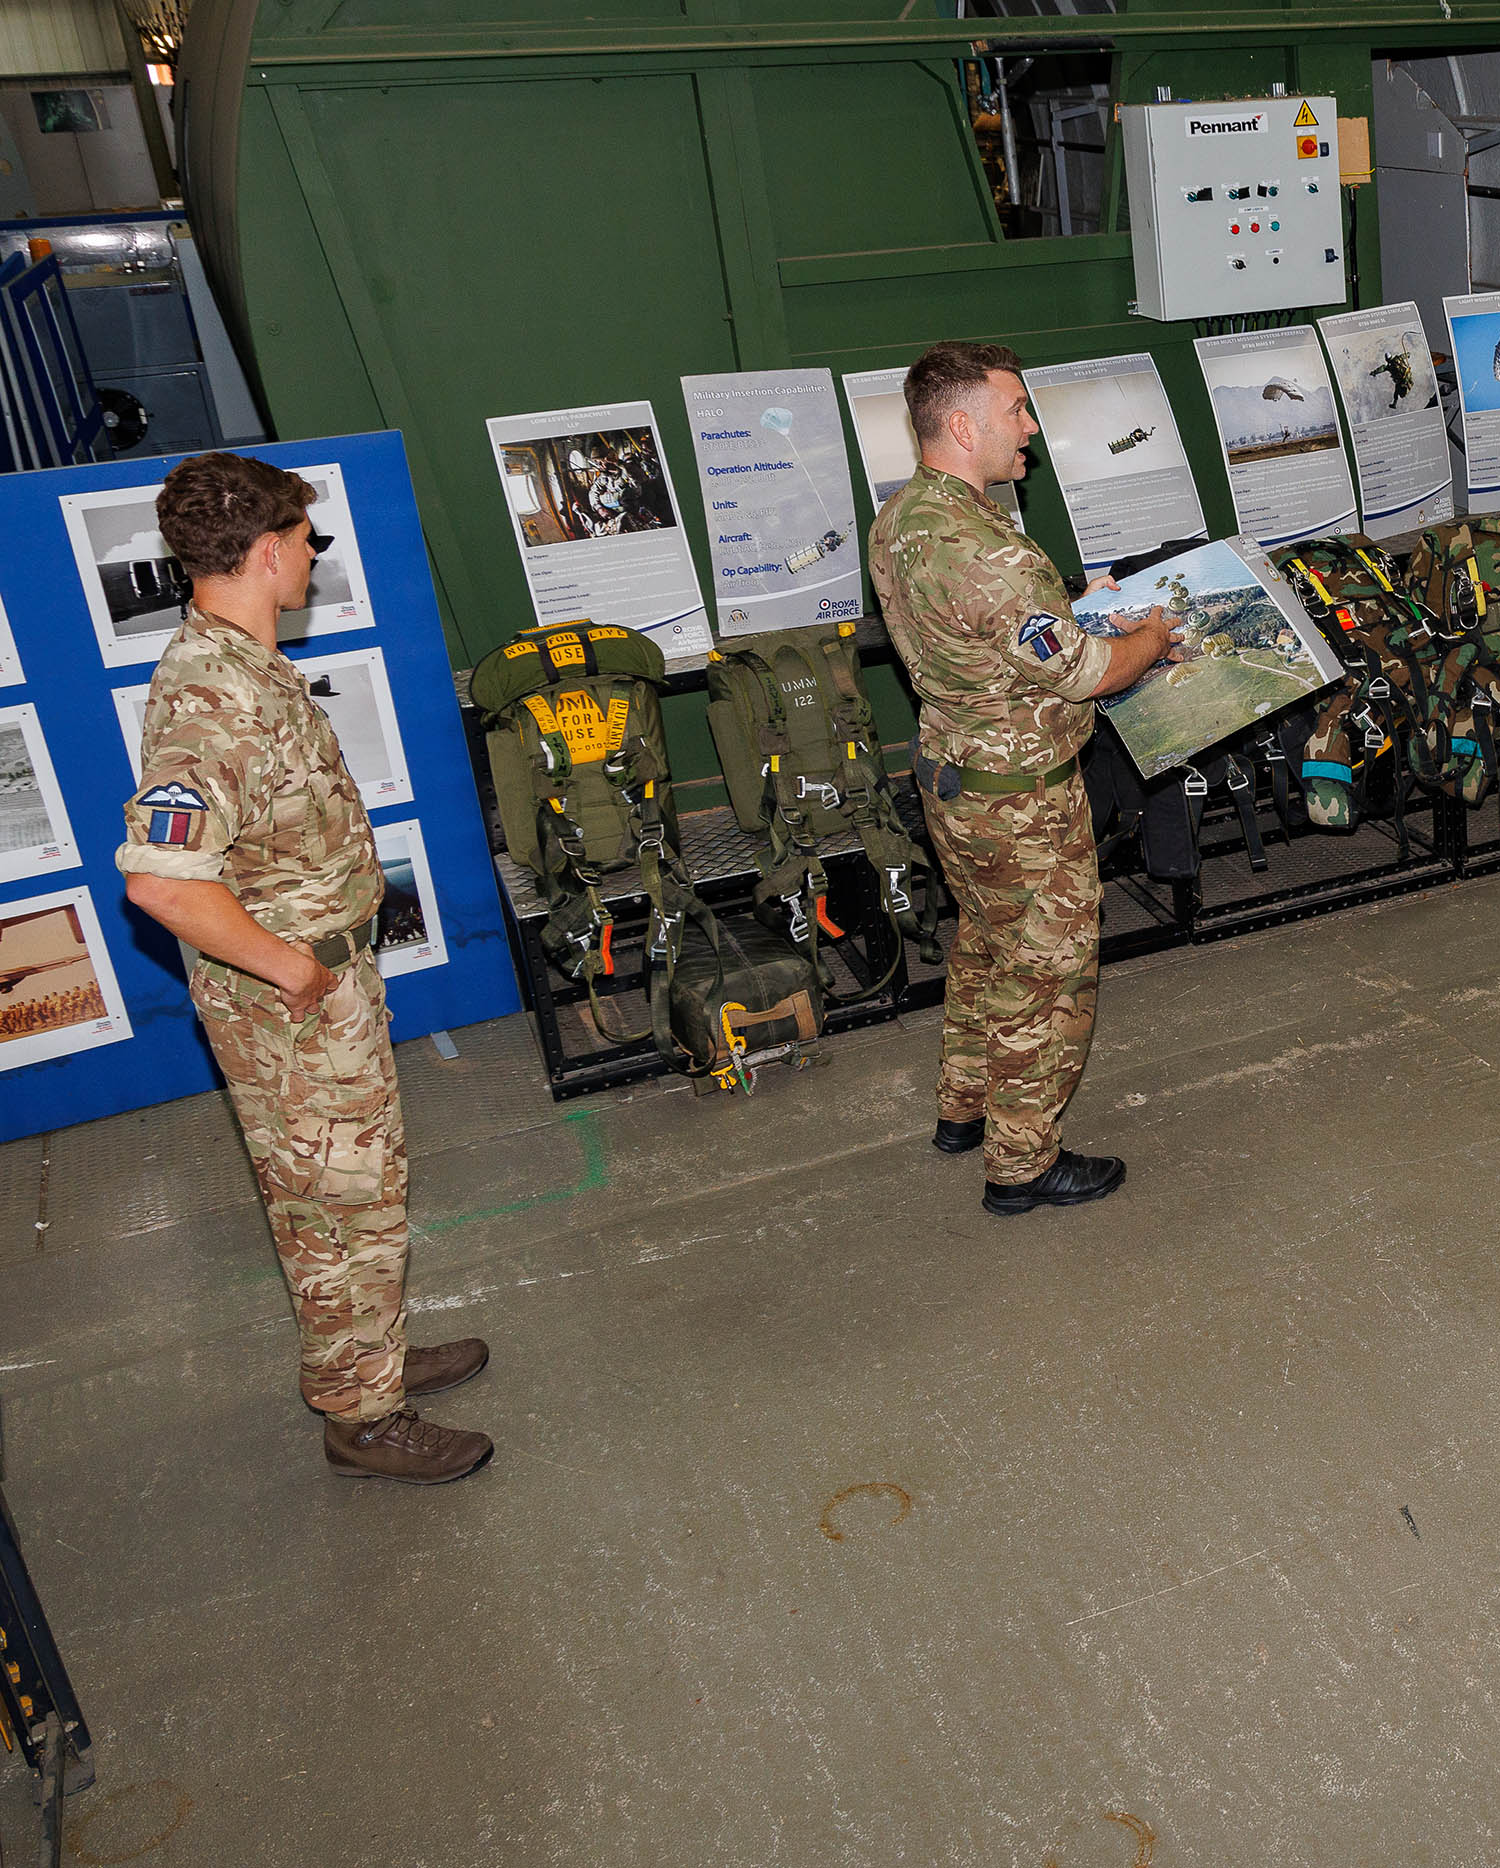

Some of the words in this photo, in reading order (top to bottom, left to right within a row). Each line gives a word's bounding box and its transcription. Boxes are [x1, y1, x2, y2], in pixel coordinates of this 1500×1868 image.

[1190, 118, 1258, 135] Pennant
[1352, 314, 1370, 322] MISSION
[1370, 310, 1388, 318] SYSTEM
[1237, 336, 1259, 344] MISSION
[1044, 367, 1070, 375] MILITARY
[1070, 364, 1094, 372] TANDEM
[1094, 360, 1128, 368] PARACHUTE
[1128, 356, 1149, 364] SYSTEM
[872, 374, 891, 382] MULTI
[693, 390, 730, 401] Military
[732, 388, 774, 398] Insertion
[774, 384, 827, 396] Capabilities
[548, 414, 569, 423] LEVEL
[570, 410, 612, 420] PARACHUTE
[696, 408, 724, 418] HALO
[701, 430, 752, 440] Parachutes:
[706, 464, 751, 476] Operation
[753, 461, 794, 472] Altitudes:
[712, 500, 738, 510] Units:
[718, 532, 753, 544] Aircraft:
[722, 568, 736, 578] Op
[737, 563, 782, 576] Capability:
[832, 598, 860, 609] ROYAL
[816, 610, 832, 620] AIR
[832, 608, 860, 618] FORCE
[507, 642, 536, 656] NOT
[548, 634, 574, 645] FOR
[590, 628, 624, 639] LIVE
[678, 638, 708, 646] Airborne
[552, 647, 583, 662] USE
[664, 646, 695, 656] Delivery
[695, 644, 710, 653] Wing
[794, 694, 816, 708] 122
[562, 713, 592, 728] FOR
[610, 702, 628, 748] DUMMY
[564, 728, 596, 742] USE
